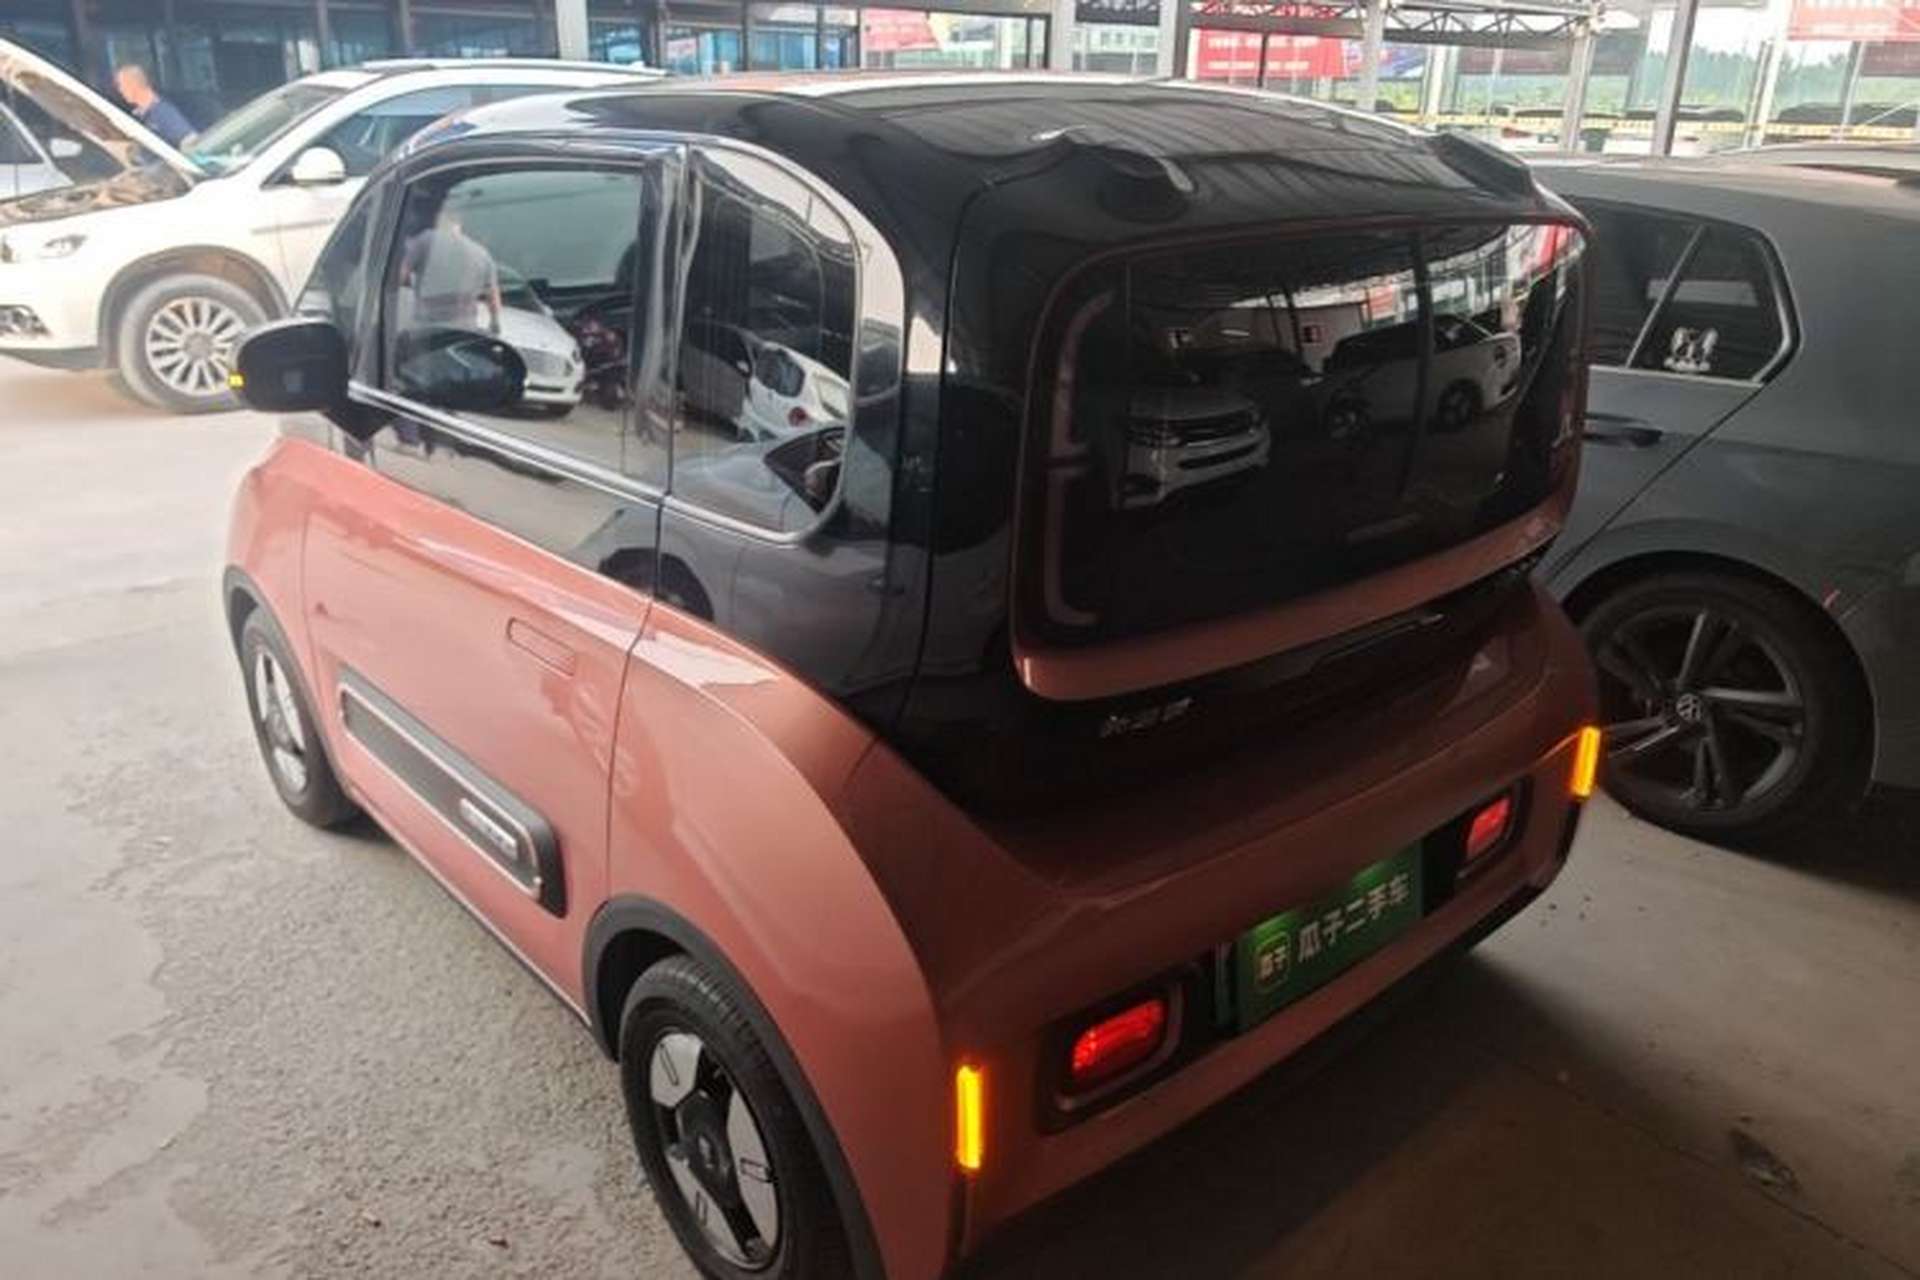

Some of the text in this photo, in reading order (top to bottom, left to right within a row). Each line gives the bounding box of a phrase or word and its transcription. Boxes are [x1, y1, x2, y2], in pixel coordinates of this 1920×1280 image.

[1298, 873, 1409, 962] 瓜子二手车
